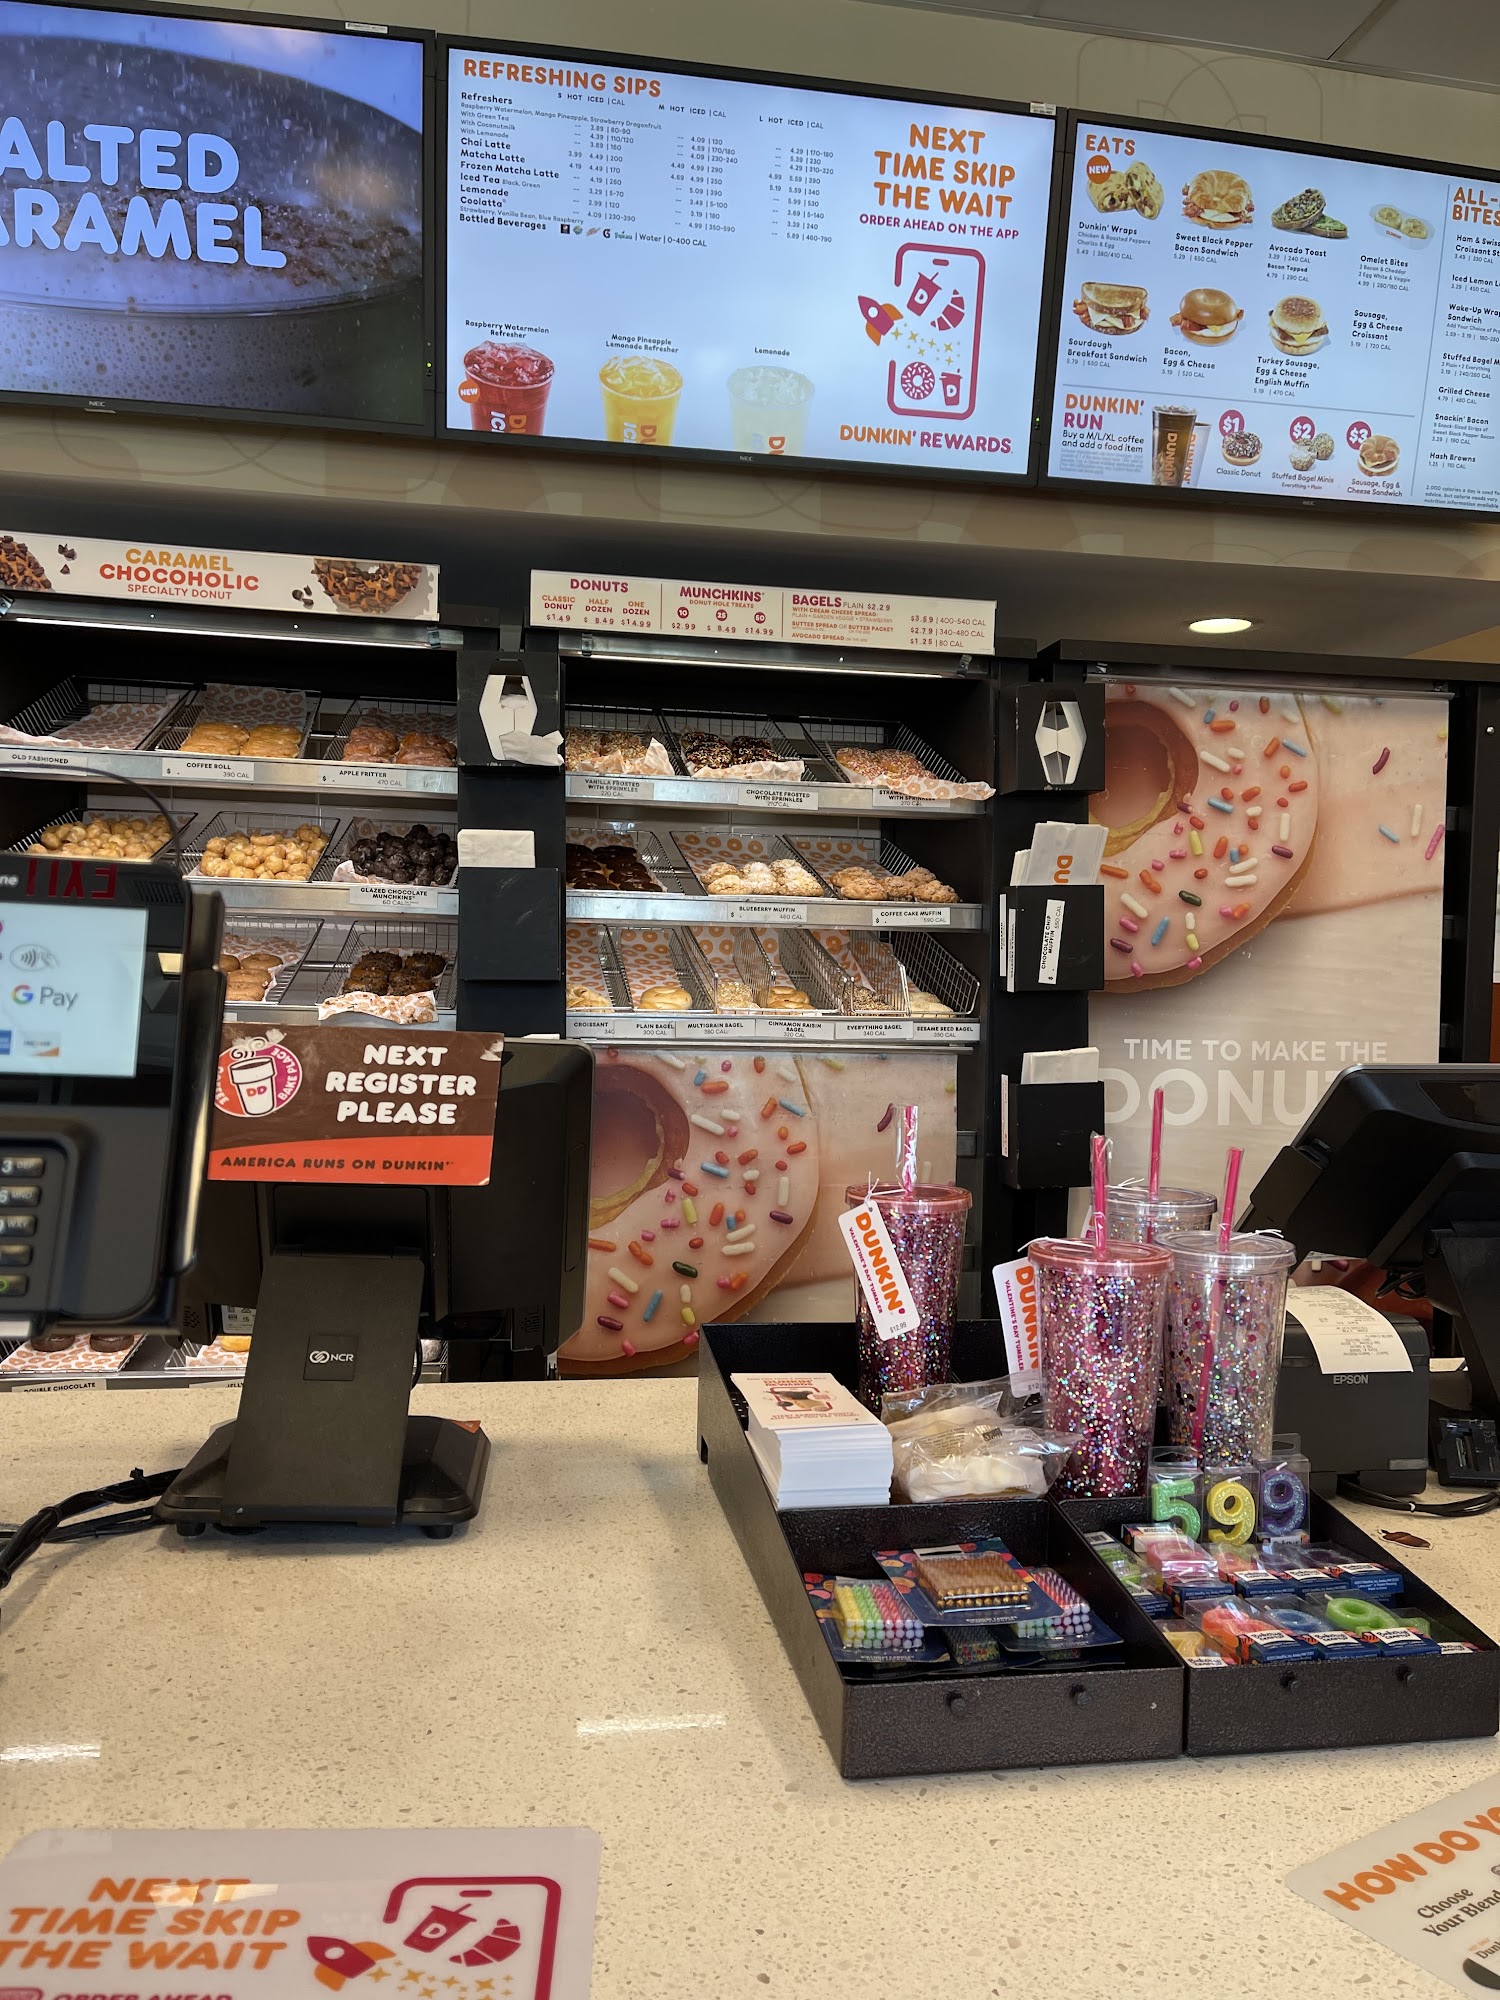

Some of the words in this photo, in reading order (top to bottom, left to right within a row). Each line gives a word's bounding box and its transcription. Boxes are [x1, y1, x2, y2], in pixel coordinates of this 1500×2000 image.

[464, 58, 606, 91] REFRESHING
[613, 75, 661, 98] SIPS
[461, 92, 513, 105] Refreshers
[461, 137, 483, 147] Chai
[484, 140, 511, 150] Latte
[910, 123, 986, 155] NEXT
[1085, 134, 1136, 156] EATS
[460, 149, 497, 160] Matcha
[499, 153, 526, 164] Latte
[460, 161, 493, 171] Frozen
[495, 164, 531, 176] Matcha
[533, 168, 560, 179] Latte
[874, 150, 946, 182] TIME
[953, 159, 1016, 189] SKIP
[1088, 165, 1109, 174] NEW
[460, 172, 480, 182] Iced
[483, 175, 500, 184] Tea
[460, 184, 509, 197] Lemonade
[874, 181, 931, 211] THE
[939, 188, 1012, 219] WAIT
[459, 213, 495, 225] Bottled
[497, 217, 547, 231] Beverages
[1452, 204, 1500, 227] BITES
[0, 188, 287, 268] RAMEL
[859, 213, 901, 228] ORDER
[904, 218, 945, 232] AHEAD
[948, 223, 966, 235] ON
[970, 225, 993, 238] THE
[996, 228, 1019, 240] APP
[1079, 221, 1109, 232] Dunkin'
[1111, 224, 1138, 236] Wraps
[639, 233, 662, 244] Water
[667, 236, 691, 246] 0-400
[692, 239, 707, 248] CAL
[1175, 232, 1200, 243] Sweet
[1202, 235, 1224, 245] Black
[1225, 237, 1254, 249] Pepper
[1174, 243, 1199, 254] Bacon
[1200, 246, 1239, 258] Sandwich
[1269, 243, 1303, 255] Avocado
[1305, 247, 1327, 258] Toast
[1360, 254, 1388, 266] Omelet
[1389, 258, 1409, 268] Bites
[465, 320, 502, 333] Raspberry
[505, 323, 550, 334] Watermelon
[490, 329, 527, 339] Refresher
[605, 340, 642, 351] Lemonade
[643, 343, 679, 354] Refresher
[611, 333, 635, 345] Mango
[637, 336, 672, 347] Pineapple
[1068, 338, 1112, 349] Sourdough
[754, 347, 790, 357] Lemonade
[1067, 349, 1107, 360] Breakfast
[1109, 352, 1148, 364] Sandwich
[460, 388, 478, 396] NEW
[1438, 386, 1463, 396] Grilled
[1464, 389, 1491, 398] Cheese
[1065, 393, 1145, 415] DUNKIN'
[1063, 412, 1103, 431] RUN
[1222, 416, 1240, 433] $1
[1434, 413, 1466, 424] Snackin'
[1466, 416, 1489, 426] Bacon
[839, 424, 916, 446] DUNKIN'
[919, 431, 1012, 454] REWARDS
[1062, 430, 1077, 440] Buy
[1086, 431, 1116, 442] M/L/XL
[1117, 434, 1145, 445] coffee
[1292, 423, 1312, 440] $2
[1349, 428, 1368, 444] $3
[1061, 439, 1078, 448] and
[1079, 440, 1095, 449] add
[1104, 442, 1123, 451] food
[1125, 444, 1143, 453] item
[125, 548, 235, 573] CARAMEL
[99, 563, 260, 592] CHOCOHOLIC
[570, 578, 629, 593] DONUTS
[127, 582, 189, 598] SPECIALTY
[190, 587, 233, 601] DONUT
[679, 586, 762, 603] MUNCHKINS
[541, 594, 576, 603] CLASSIC
[588, 597, 609, 606] HALF
[628, 600, 645, 608] ONE
[544, 602, 573, 611] DONUT
[585, 605, 613, 614] DOZEN
[622, 607, 650, 616] DOZEN
[792, 594, 842, 608] BAGELS
[843, 601, 864, 610] PLAIN
[678, 608, 688, 617] 10
[716, 611, 727, 620] 25
[754, 613, 765, 622] 50
[972, 619, 987, 627] CAL
[186, 761, 212, 770] COFFEE
[213, 762, 232, 770] ROLL
[339, 769, 360, 777] APPLE
[746, 789, 783, 797] CHOCOLATE
[784, 791, 810, 799] FROSTED
[360, 887, 387, 895] GLAZED
[387, 889, 428, 897] CHOCOLATE
[372, 893, 413, 901] MUNCHKINS
[39, 986, 79, 1011] Pay
[363, 1043, 449, 1067] NEXT
[1123, 1038, 1192, 1061] TIME
[1202, 1039, 1242, 1062] TO
[1251, 1040, 1326, 1062] MAKE
[1335, 1041, 1388, 1062] THE
[270, 1047, 298, 1074] PLACE
[246, 1085, 267, 1097] DD
[277, 1075, 298, 1101] BAKE
[325, 1071, 477, 1096] REGISTER
[1099, 1068, 1342, 1126] DONU
[336, 1100, 458, 1125] PLEASE
[220, 1156, 297, 1168] AMERICA
[303, 1158, 346, 1169] RUNS
[351, 1159, 376, 1169] ON
[848, 1227, 867, 1269] VALENTINE'S
[864, 1268, 872, 1282] DAY
[869, 1283, 883, 1314] TUMBLER
[855, 1212, 906, 1315] DUNKIN'
[889, 1321, 907, 1334] $12.99
[330, 1352, 354, 1363] NCR
[1333, 1374, 1369, 1385] EPSON
[1151, 1478, 1201, 1541] 5
[1206, 1481, 1257, 1546] 9
[1261, 1470, 1306, 1536] 9
[1322, 1853, 1428, 1911] HOW
[1413, 1830, 1480, 1865] DO
[87, 1877, 252, 1904] NEXT
[1417, 1888, 1474, 1919] Choose
[8, 1906, 156, 1936] TIME
[166, 1907, 302, 1937] SKIP
[1422, 1912, 1466, 1937] Your
[0, 1940, 111, 1970] THE
[124, 1940, 288, 1972] WAIT
